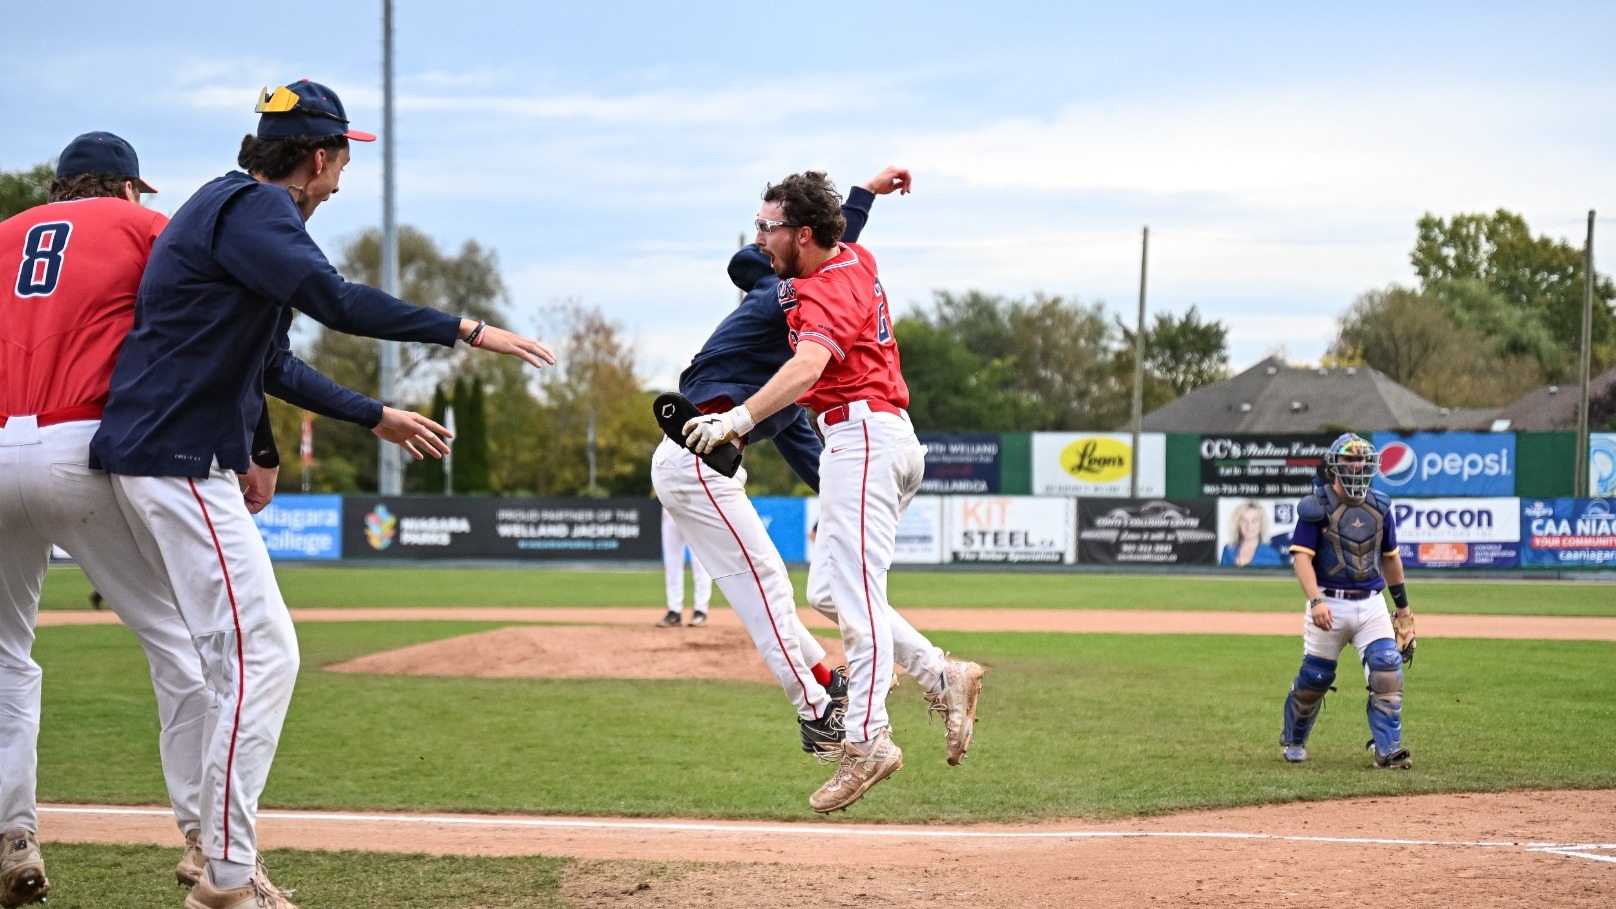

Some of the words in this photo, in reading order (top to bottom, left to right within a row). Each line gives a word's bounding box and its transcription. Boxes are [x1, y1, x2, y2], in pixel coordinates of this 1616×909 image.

[15, 221, 73, 298] 8
[1070, 440, 1125, 475] Leon's
[1201, 439, 1241, 459] CC's
[1421, 447, 1508, 481] pepsi
[1394, 504, 1493, 528] Procon
[1532, 519, 1572, 536] CAA
[1535, 537, 1561, 547] YOUR
